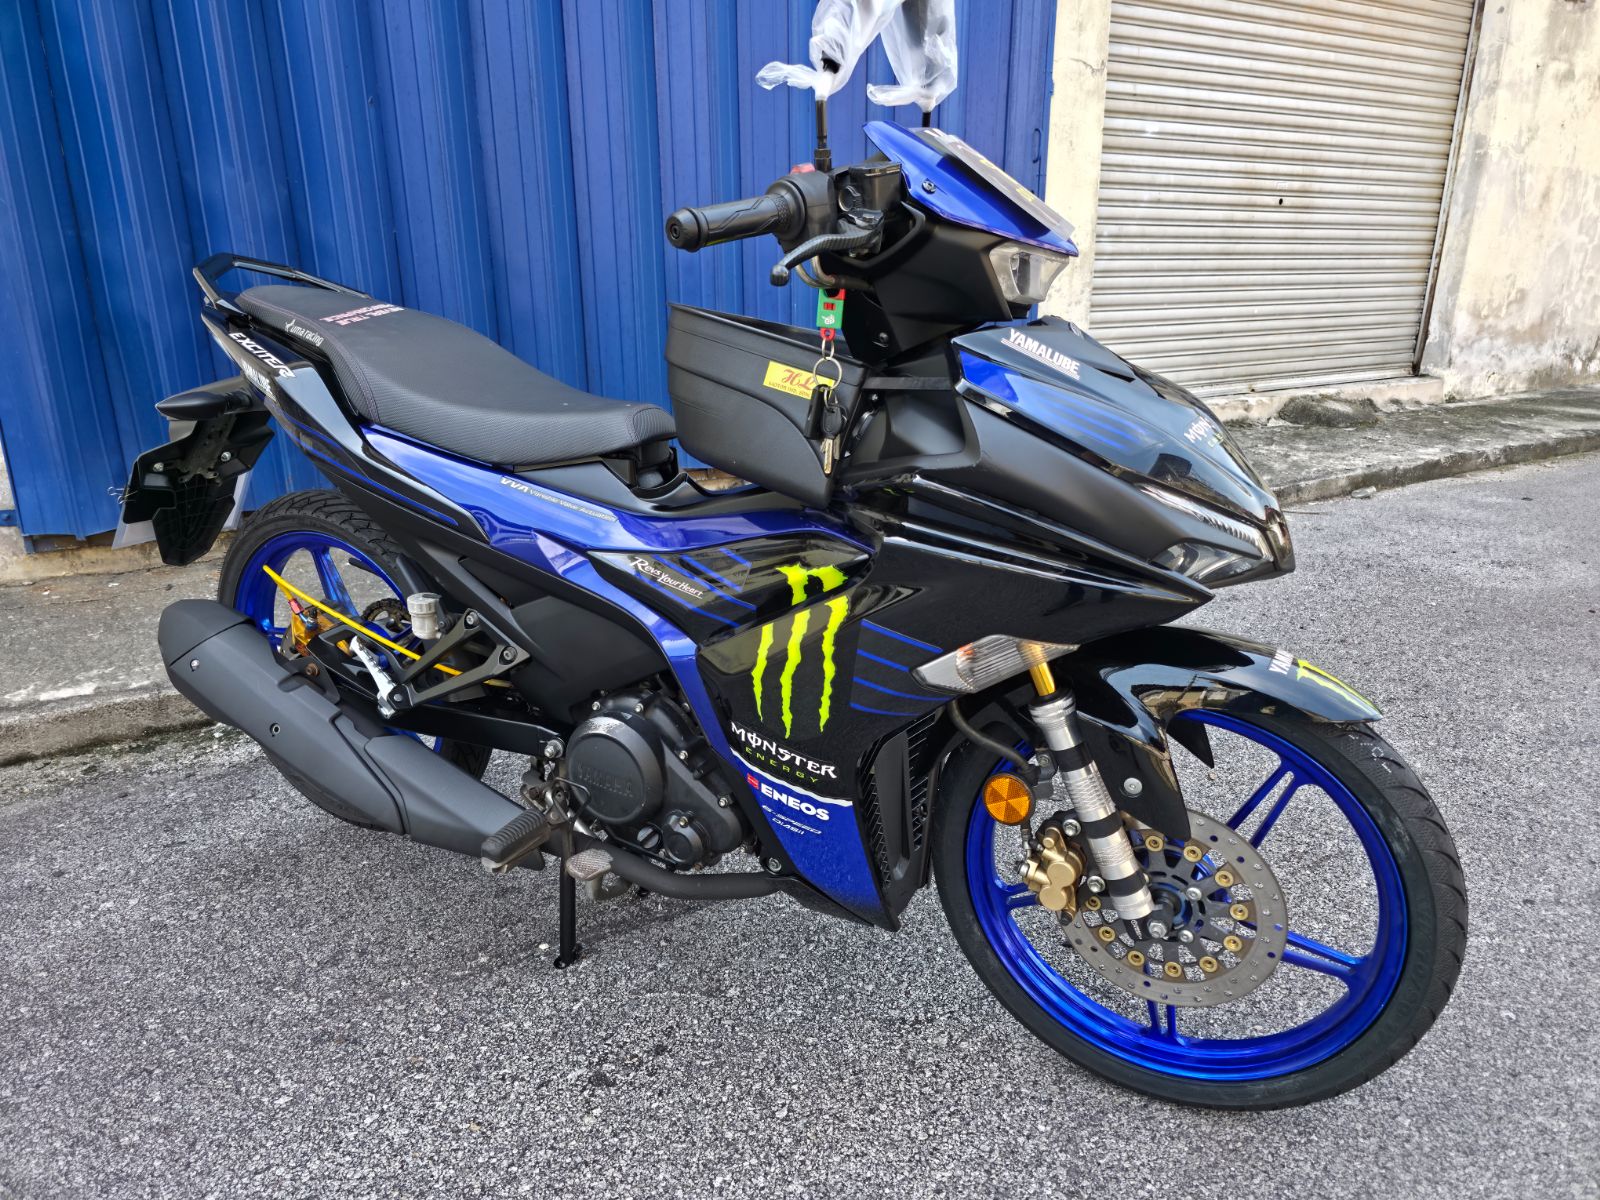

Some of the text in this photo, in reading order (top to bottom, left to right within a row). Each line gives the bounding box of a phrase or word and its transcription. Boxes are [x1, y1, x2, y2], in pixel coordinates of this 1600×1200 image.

[228, 332, 296, 378] EXCITER
[1008, 328, 1081, 375] YAMALUBE
[500, 476, 529, 493] VVA
[629, 556, 704, 597] Revs Your Heart
[731, 721, 837, 778] MONSTER
[745, 746, 819, 783] ENERGY
[761, 782, 830, 821] ENEOS
